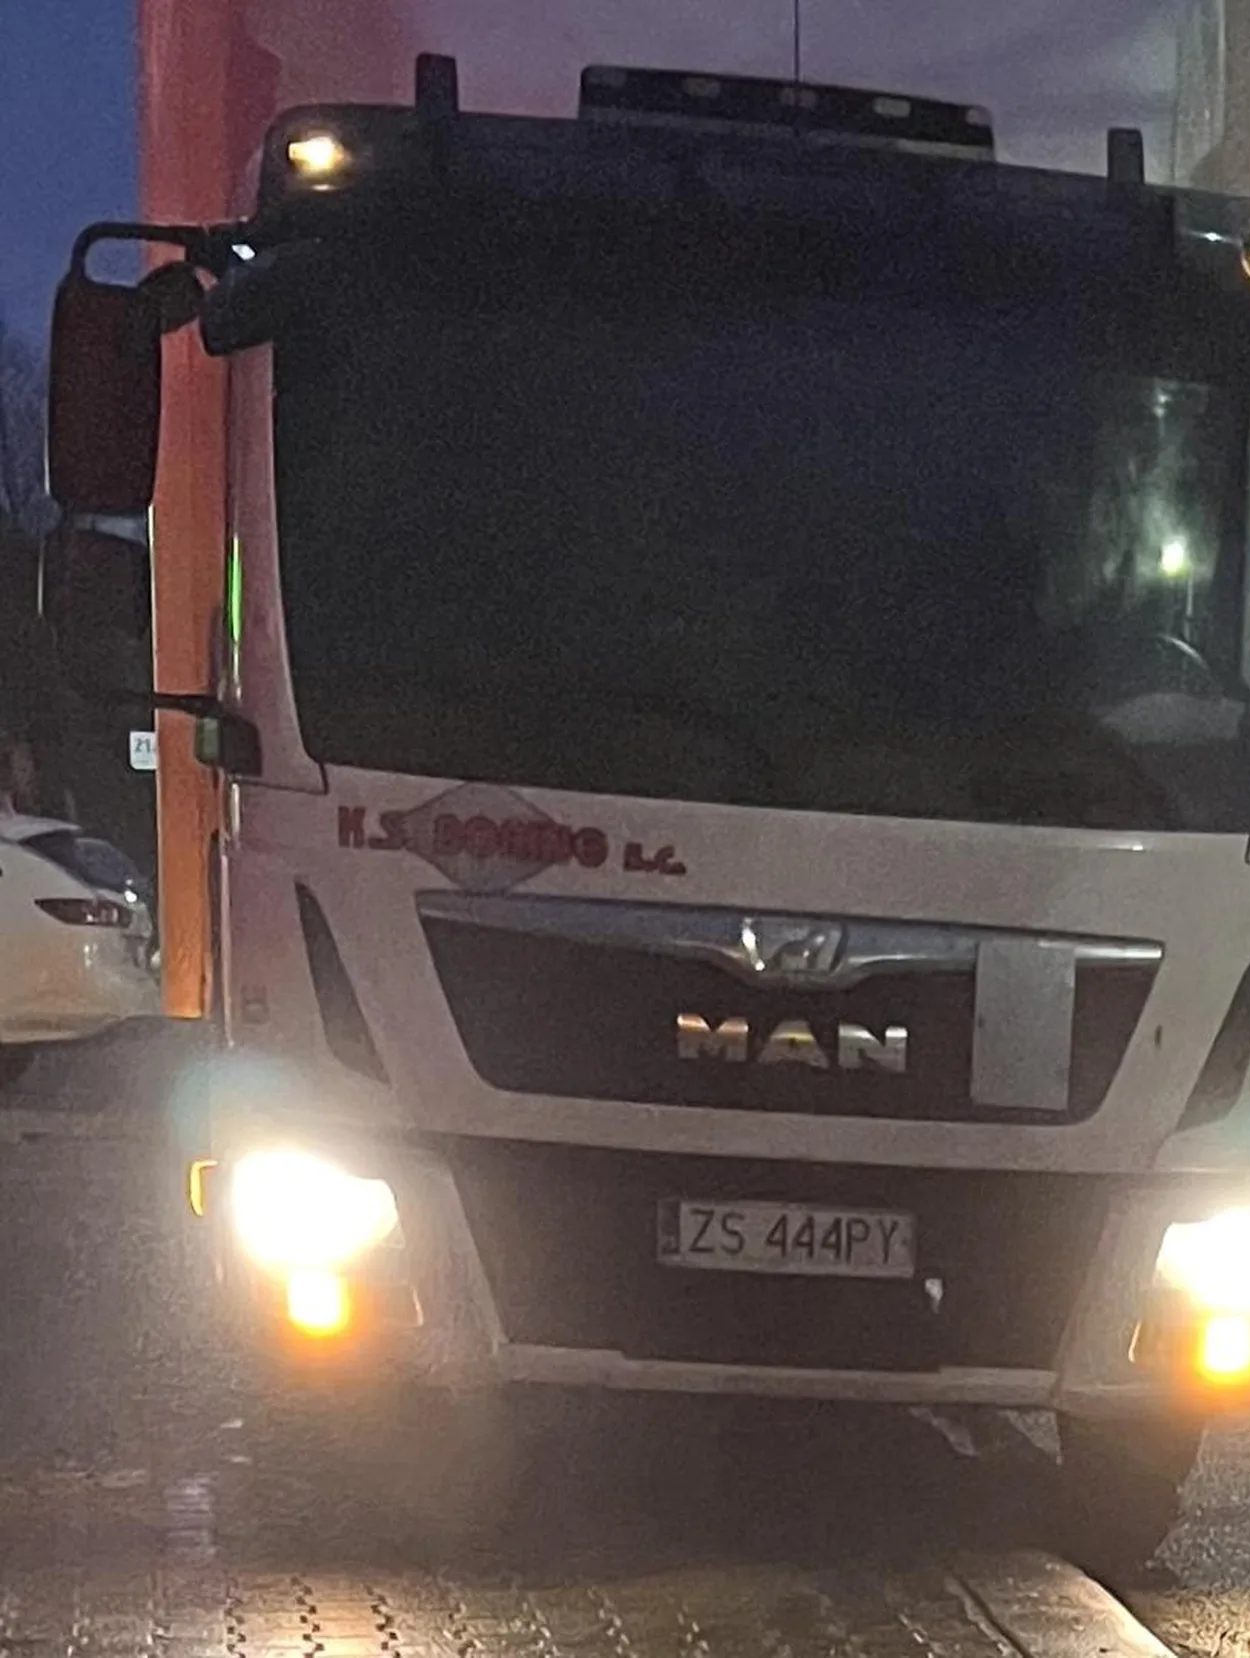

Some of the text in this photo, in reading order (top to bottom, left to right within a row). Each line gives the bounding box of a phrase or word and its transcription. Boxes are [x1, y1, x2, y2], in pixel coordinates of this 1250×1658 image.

[676, 1012, 908, 1072] MAN
[688, 1207, 746, 1256] ZS
[765, 1213, 898, 1265] 444PY
